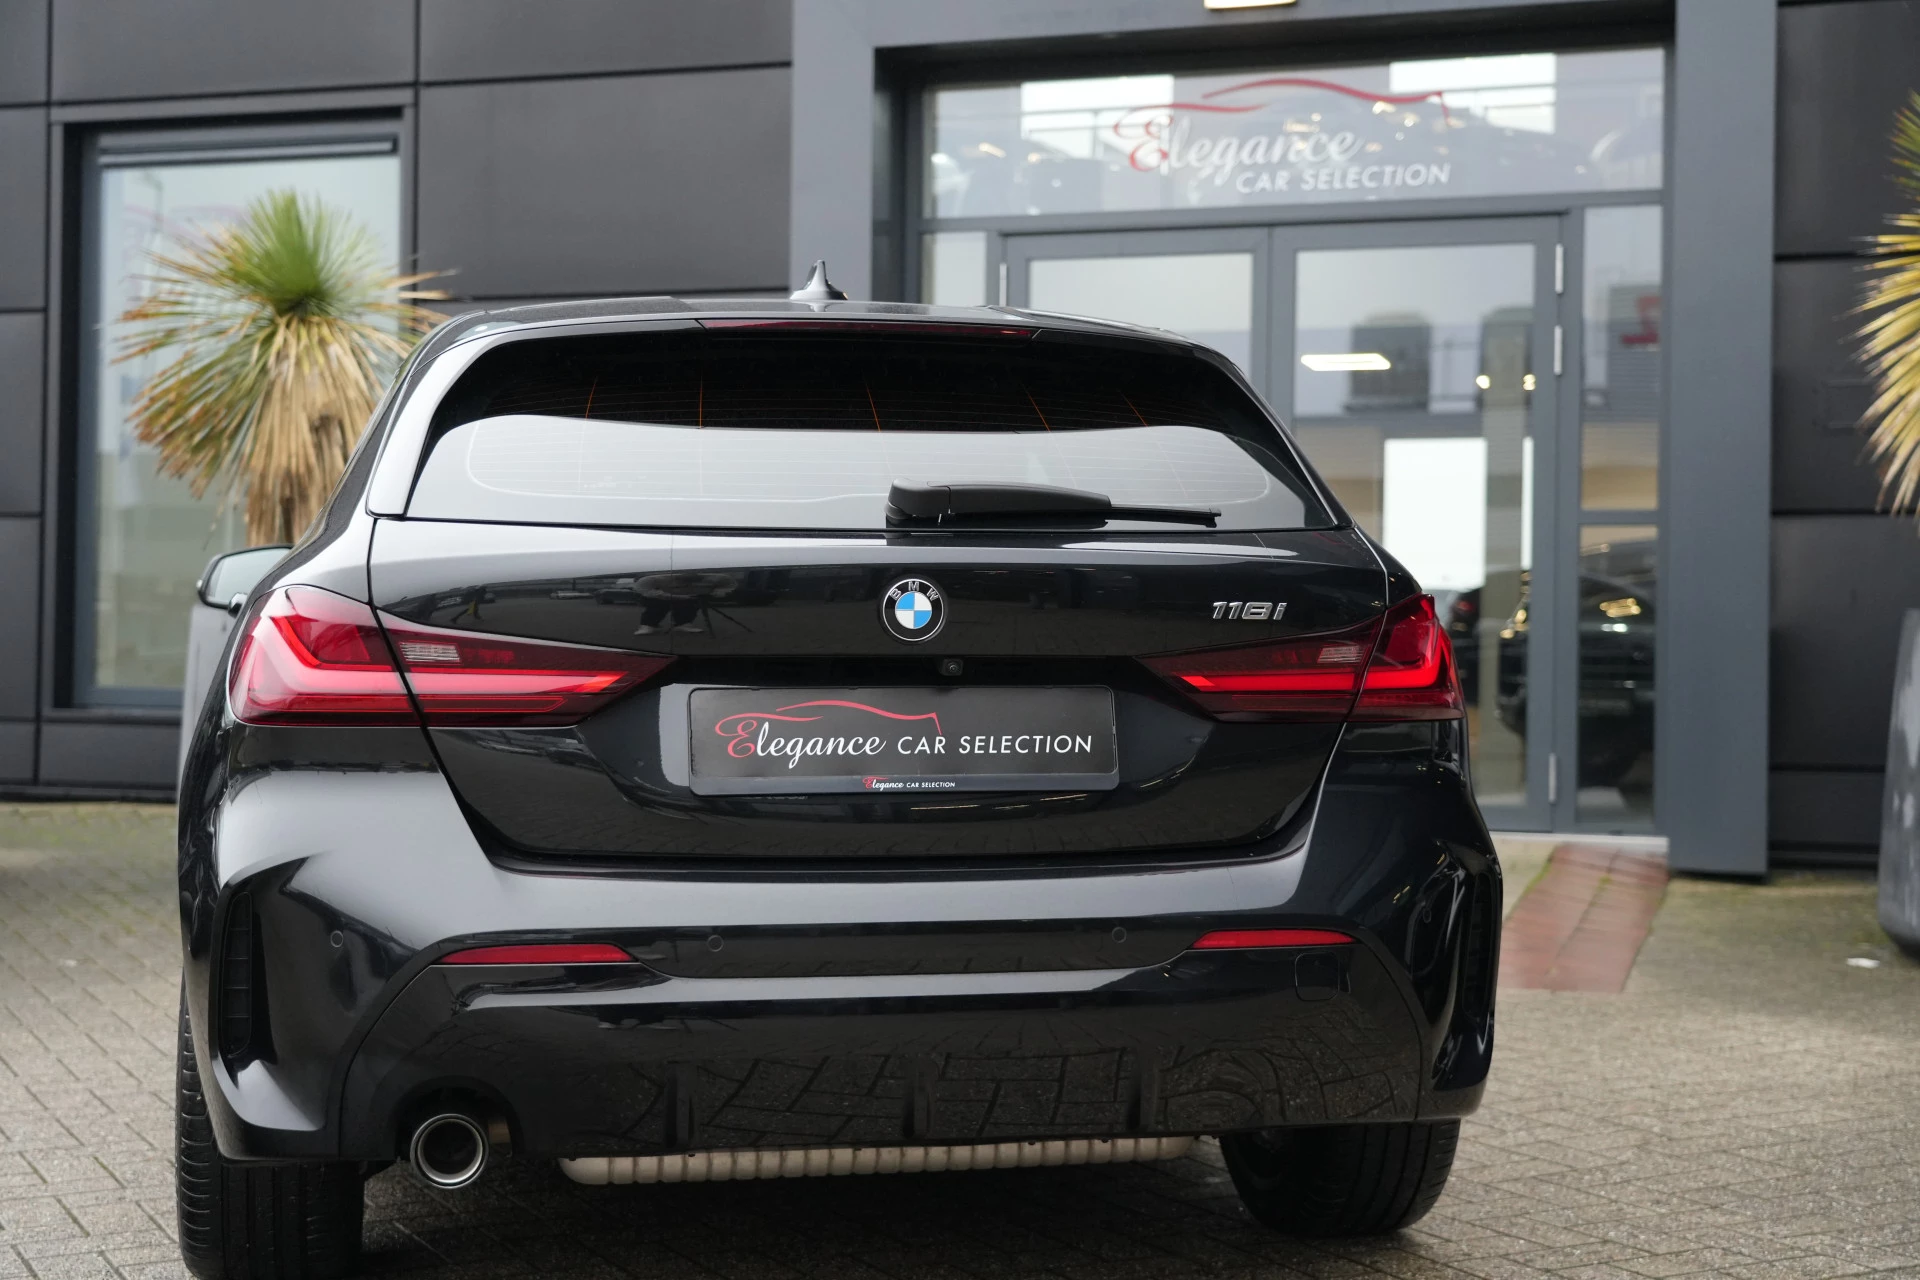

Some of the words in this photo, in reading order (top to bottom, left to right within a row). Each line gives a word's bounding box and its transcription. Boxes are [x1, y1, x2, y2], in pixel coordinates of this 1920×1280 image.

[1114, 104, 1366, 187] Elegance
[1235, 170, 1290, 194] CAR
[1300, 162, 1451, 192] SELECTION
[889, 580, 939, 602] BMW
[1212, 601, 1288, 620] 118i
[714, 712, 887, 770] Elegance
[897, 736, 946, 755] CAR
[958, 735, 1092, 754] SELECTION
[862, 776, 904, 791] Elegance
